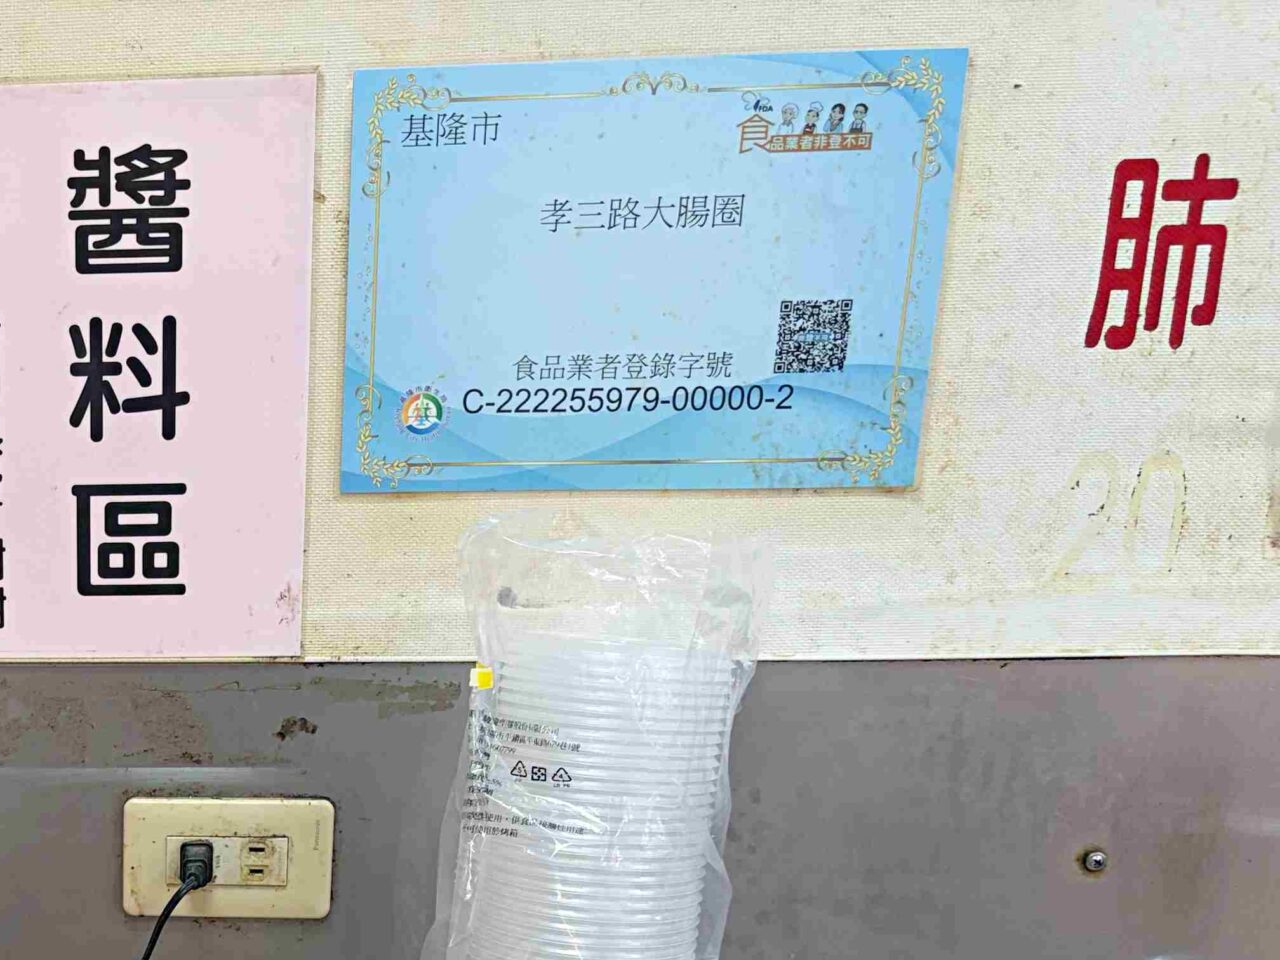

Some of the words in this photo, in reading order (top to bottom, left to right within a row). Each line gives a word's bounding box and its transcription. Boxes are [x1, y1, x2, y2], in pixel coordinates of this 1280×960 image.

[401, 111, 502, 148] 基隆市
[540, 194, 746, 232] 孝三路大腸圈
[1084, 153, 1238, 350] 肺
[67, 143, 191, 597] 醬料區
[512, 350, 733, 381] 食品業者登錄字號
[462, 384, 794, 414] C-222255979-00000-2
